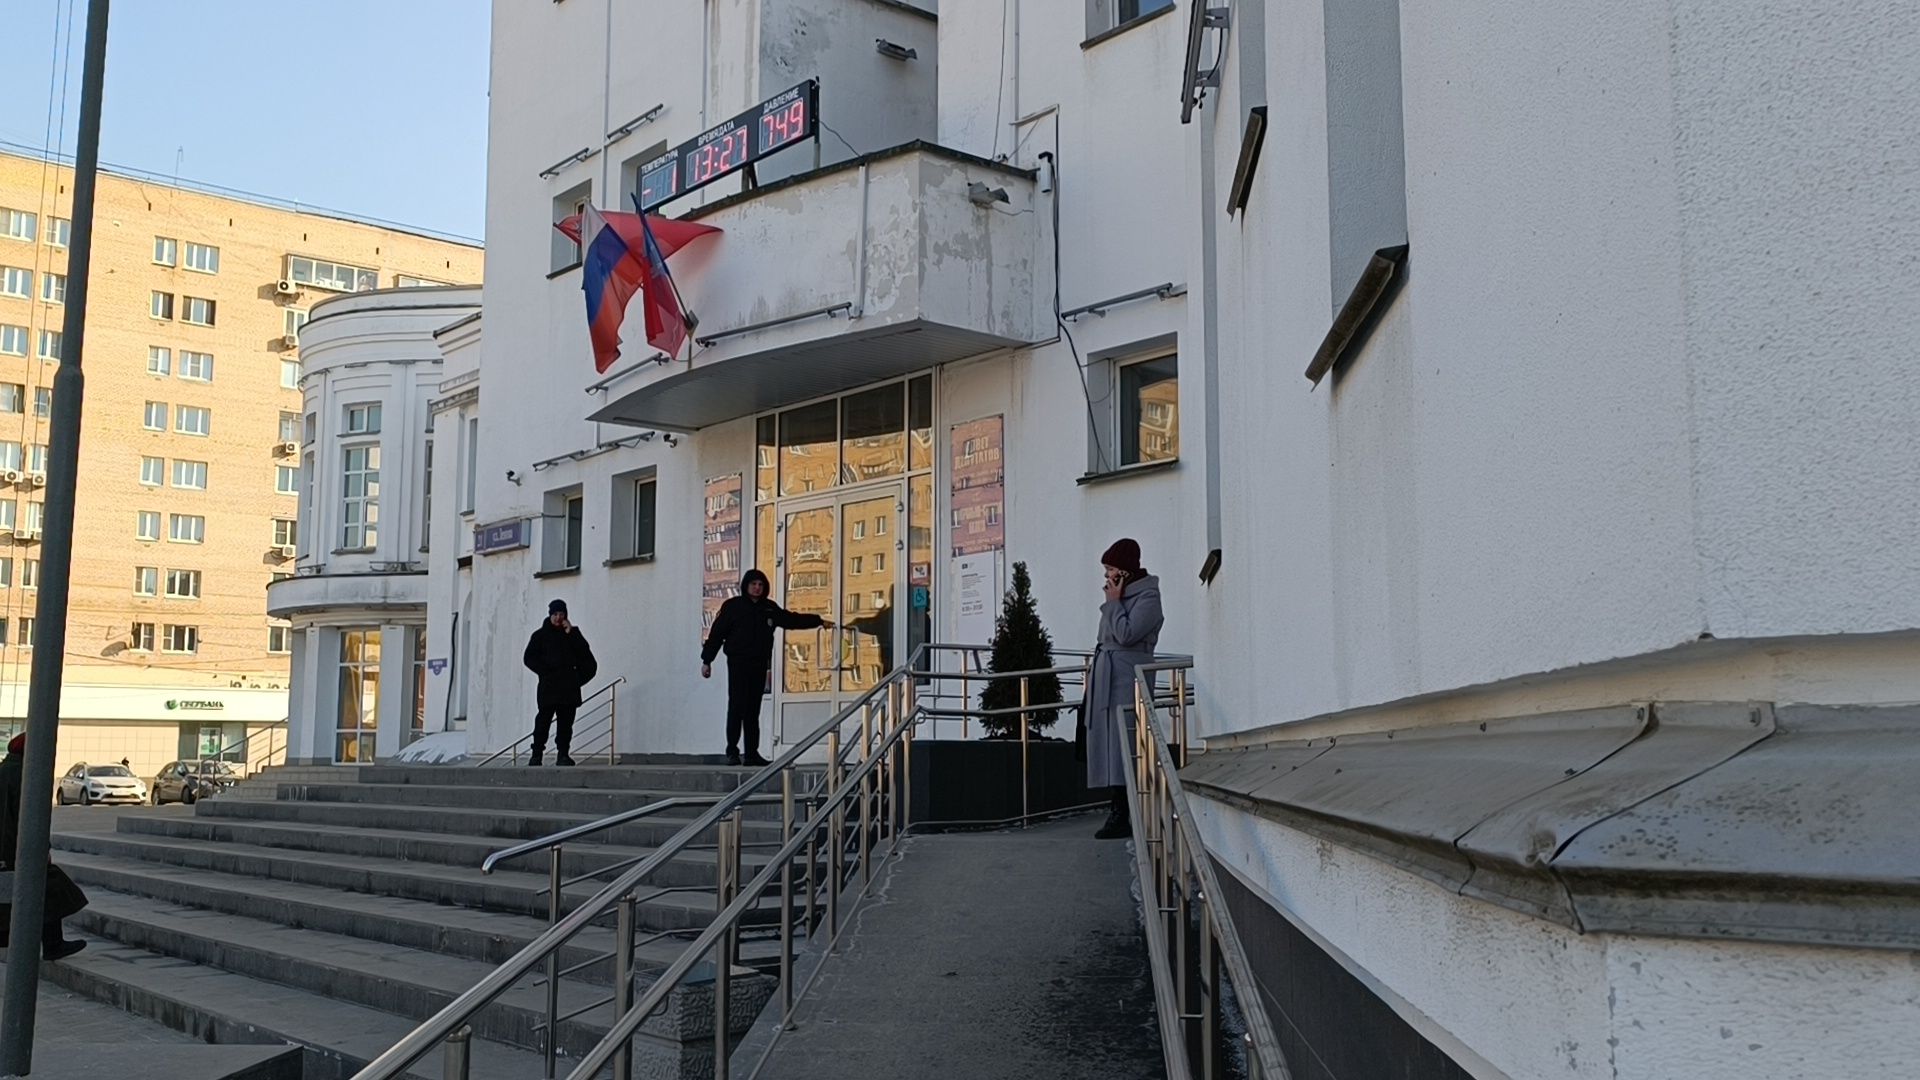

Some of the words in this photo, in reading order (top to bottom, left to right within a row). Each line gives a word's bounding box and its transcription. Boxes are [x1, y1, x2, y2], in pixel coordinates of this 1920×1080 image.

[763, 87, 800, 114] ДАВЛЕНИЕ
[763, 101, 803, 146] 749
[694, 127, 748, 181] 13:27
